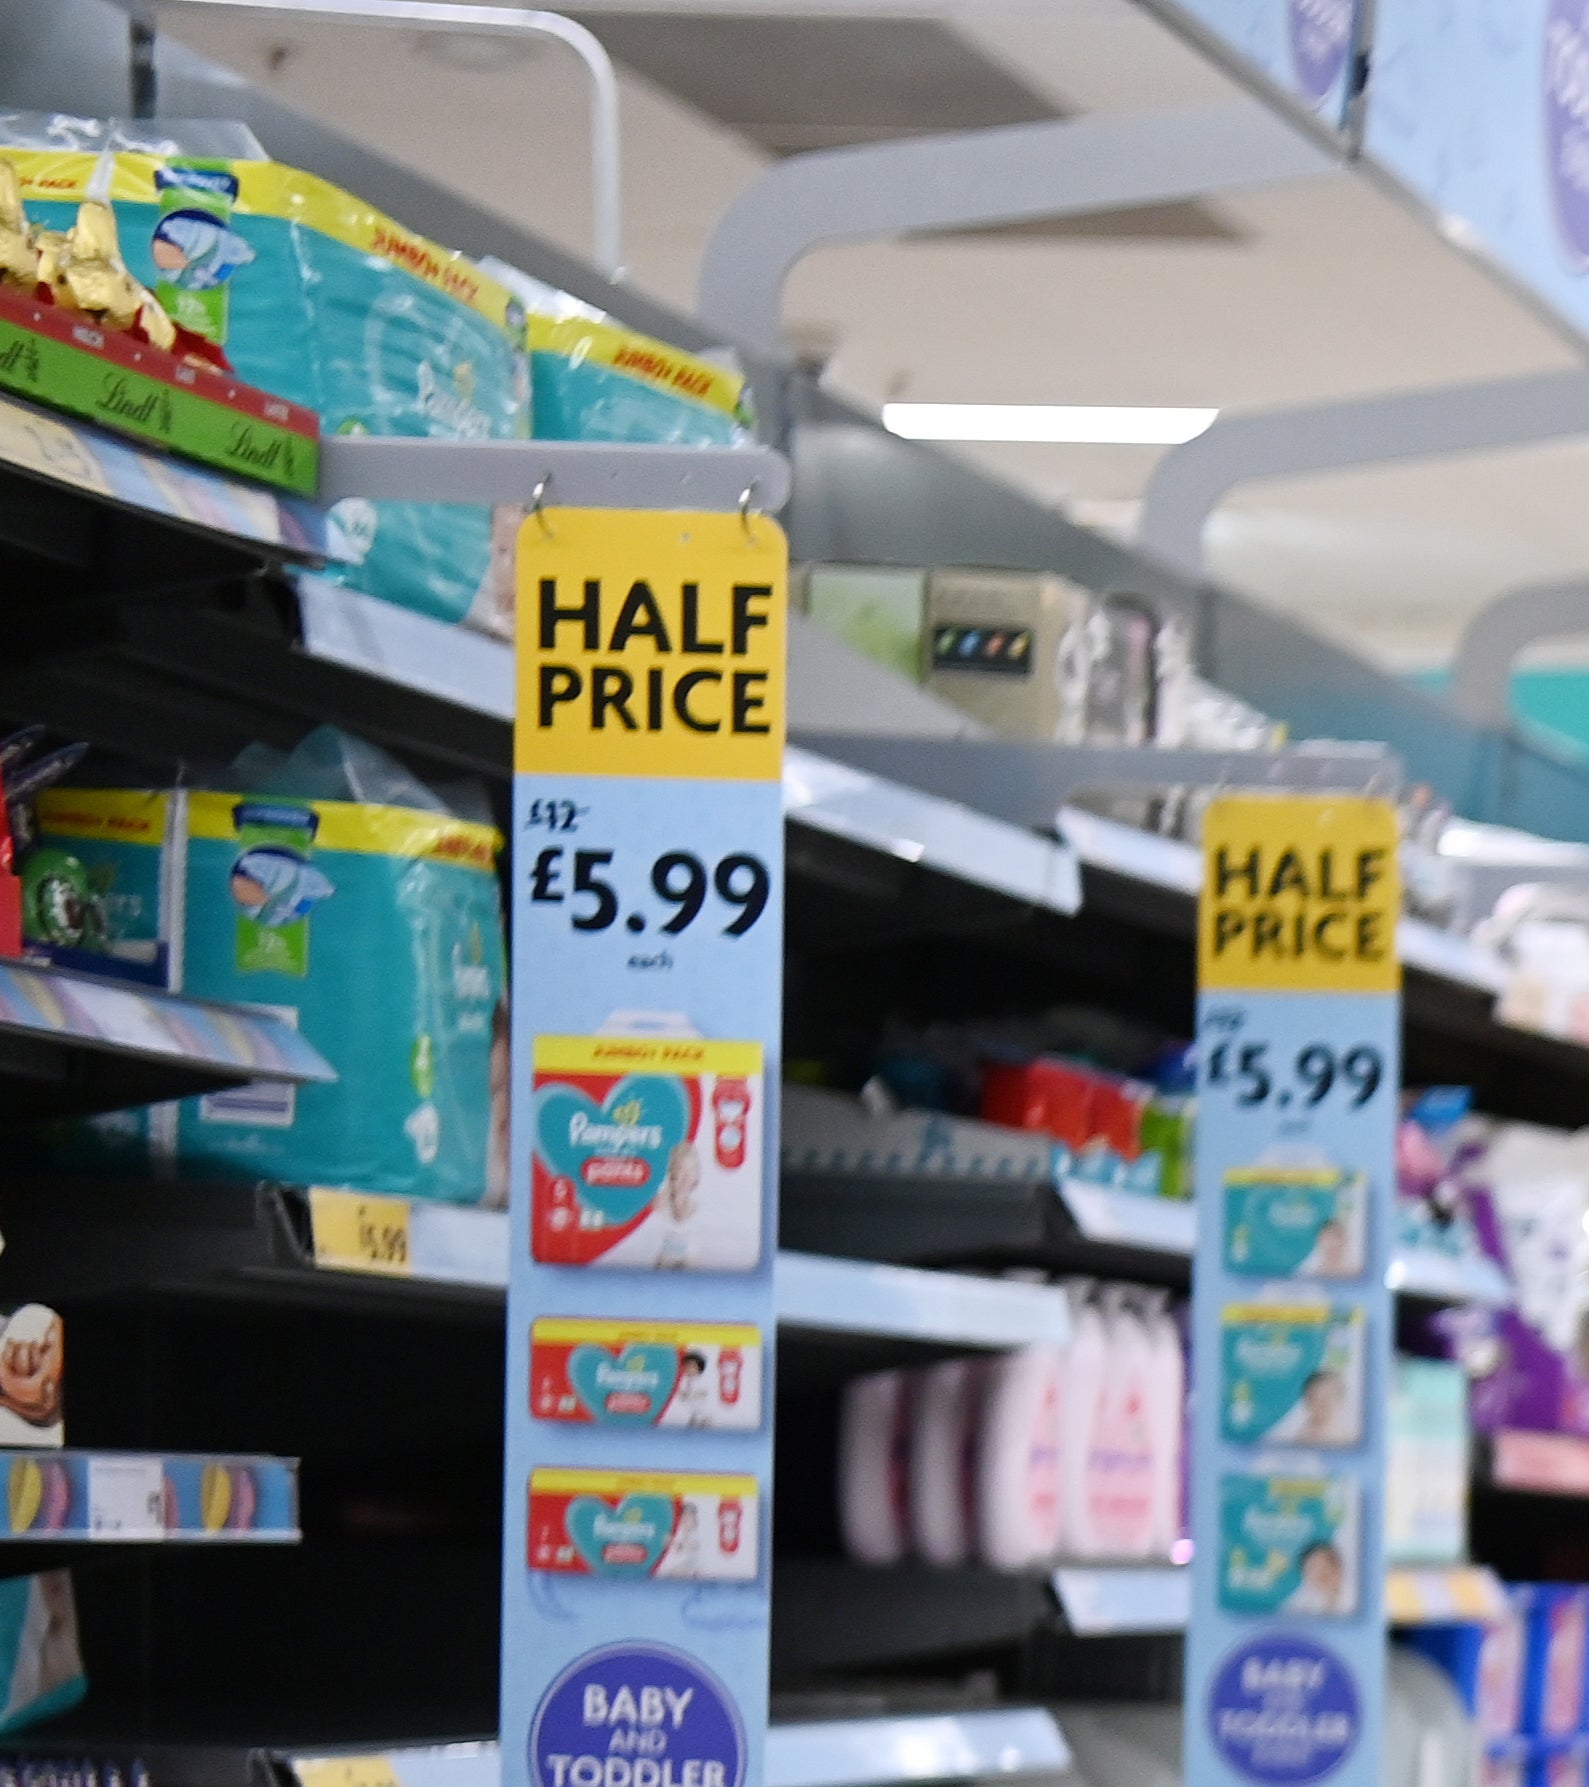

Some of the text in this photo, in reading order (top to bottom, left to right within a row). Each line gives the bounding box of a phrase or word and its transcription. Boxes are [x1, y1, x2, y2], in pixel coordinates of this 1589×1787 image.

[537, 576, 773, 656] HALF
[537, 662, 771, 736] PRICE
[530, 846, 771, 937] £5.99
[1211, 842, 1388, 901] HALF
[627, 950, 674, 972] each
[1211, 908, 1387, 962] PRICE
[1207, 1040, 1385, 1111] £5.99
[569, 1110, 663, 1150] Pampers
[583, 1683, 695, 1729] BABY
[608, 1729, 668, 1756] AND
